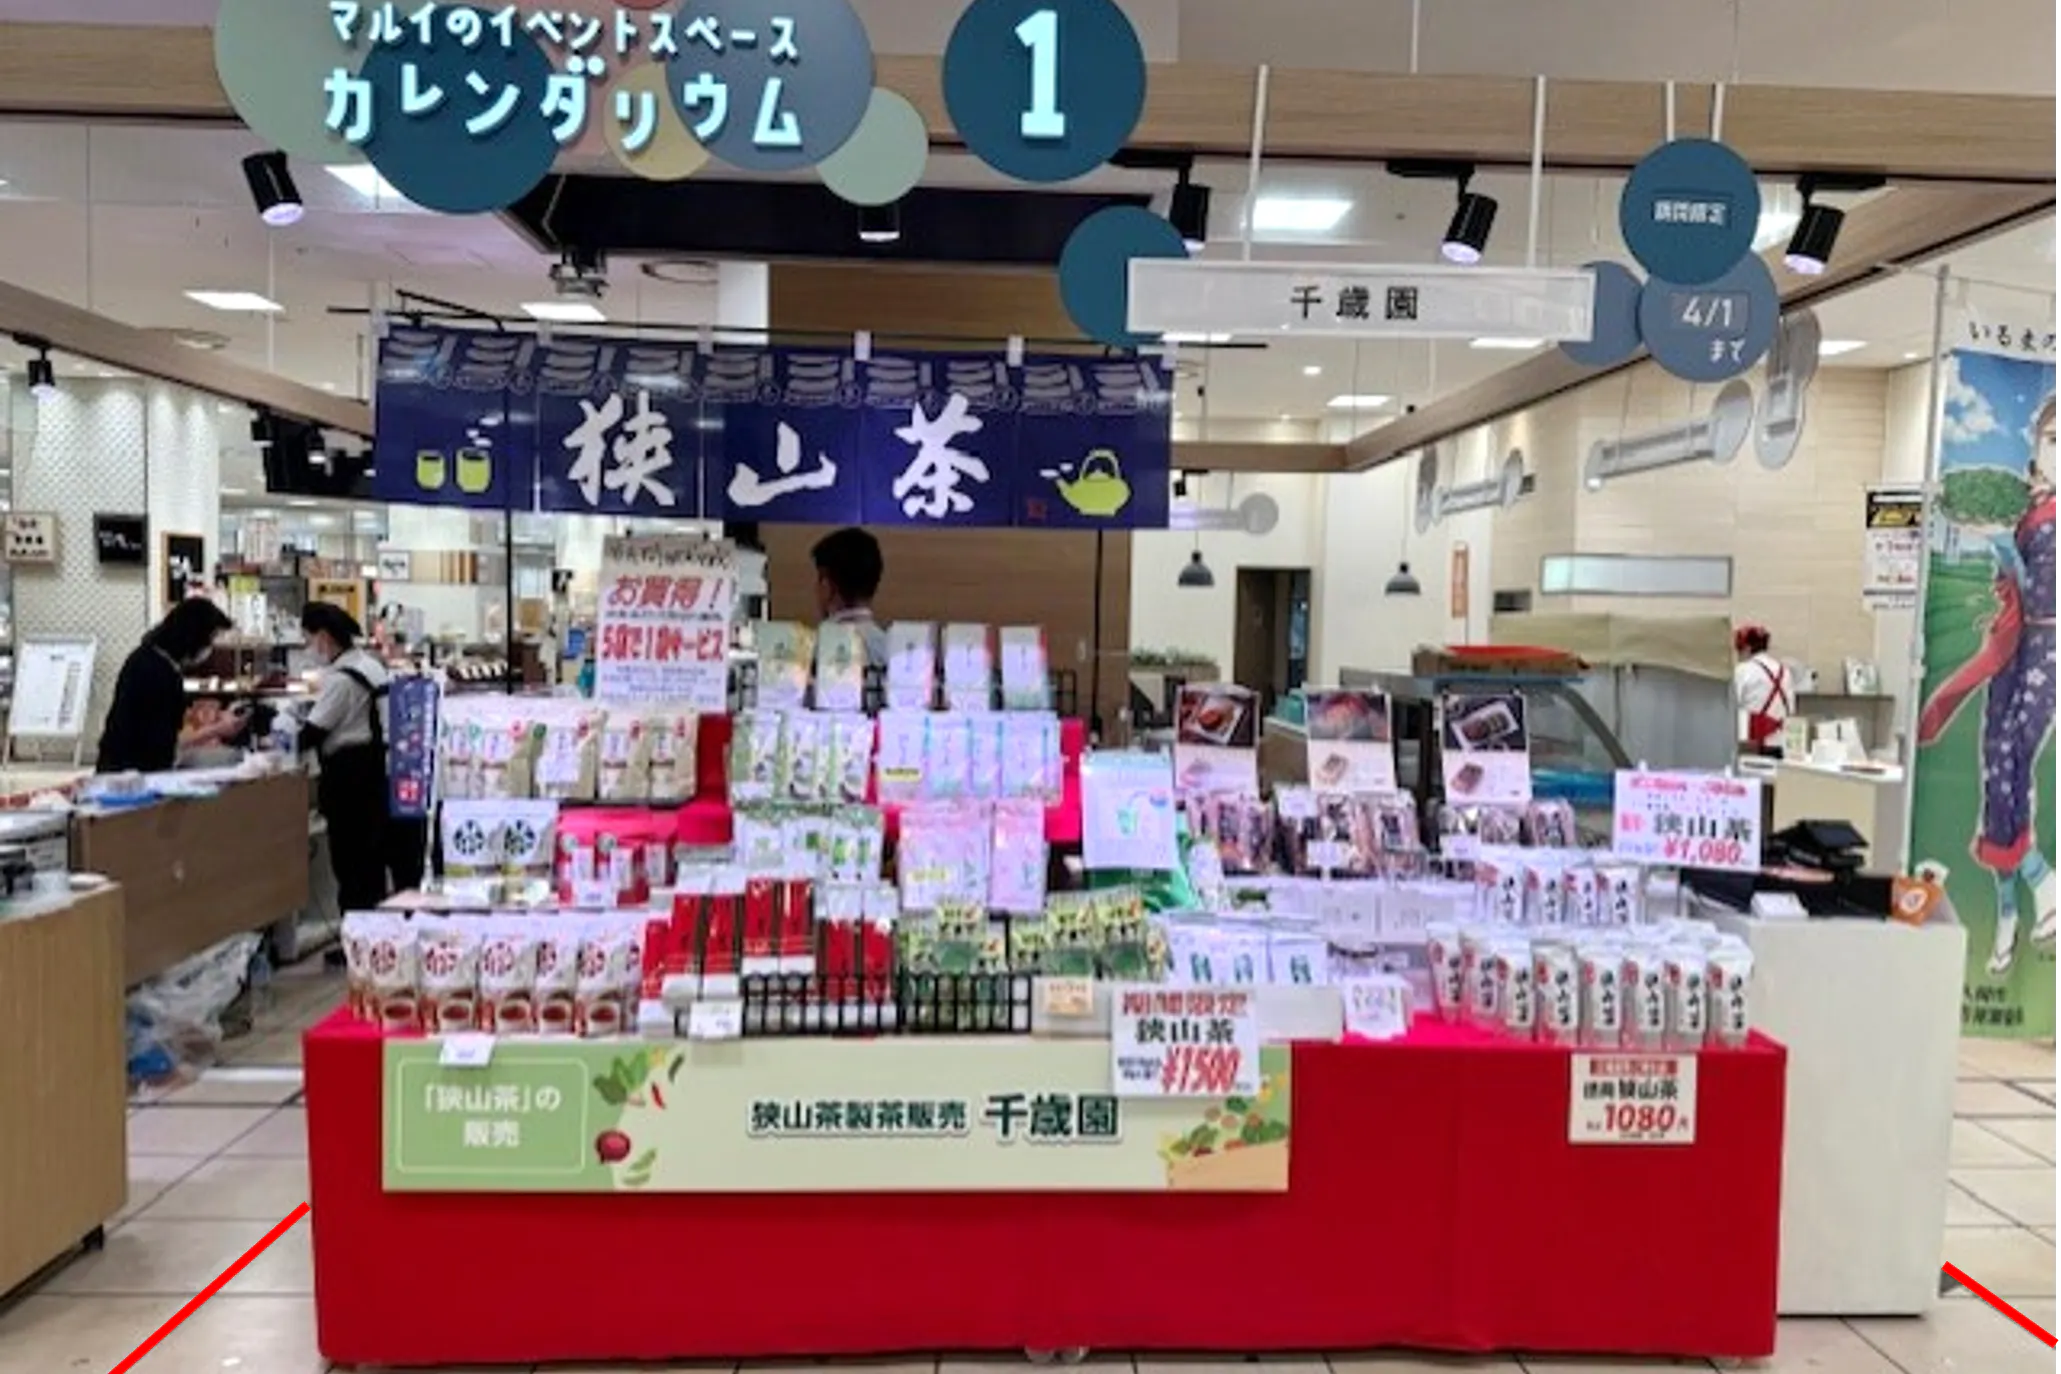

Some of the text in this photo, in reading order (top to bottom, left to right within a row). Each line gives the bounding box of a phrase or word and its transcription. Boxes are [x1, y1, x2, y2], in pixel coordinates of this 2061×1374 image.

[329, 0, 799, 59] マルイのイベントスペース
[1015, 10, 1066, 138] 1
[324, 53, 803, 150] カレンダリウム
[1291, 286, 1418, 320] 千歳園
[1682, 295, 1733, 327] 4/1
[1710, 339, 1746, 363] まで
[564, 391, 991, 519] 狭山茶
[1655, 812, 1752, 843] 狭山茶
[1137, 1018, 1234, 1044] 狭山茶
[424, 1083, 561, 1113] 「狭山茶」の
[750, 1093, 1121, 1137] 狭山茶製茶販売 千歳園
[462, 1119, 521, 1147] 販売
